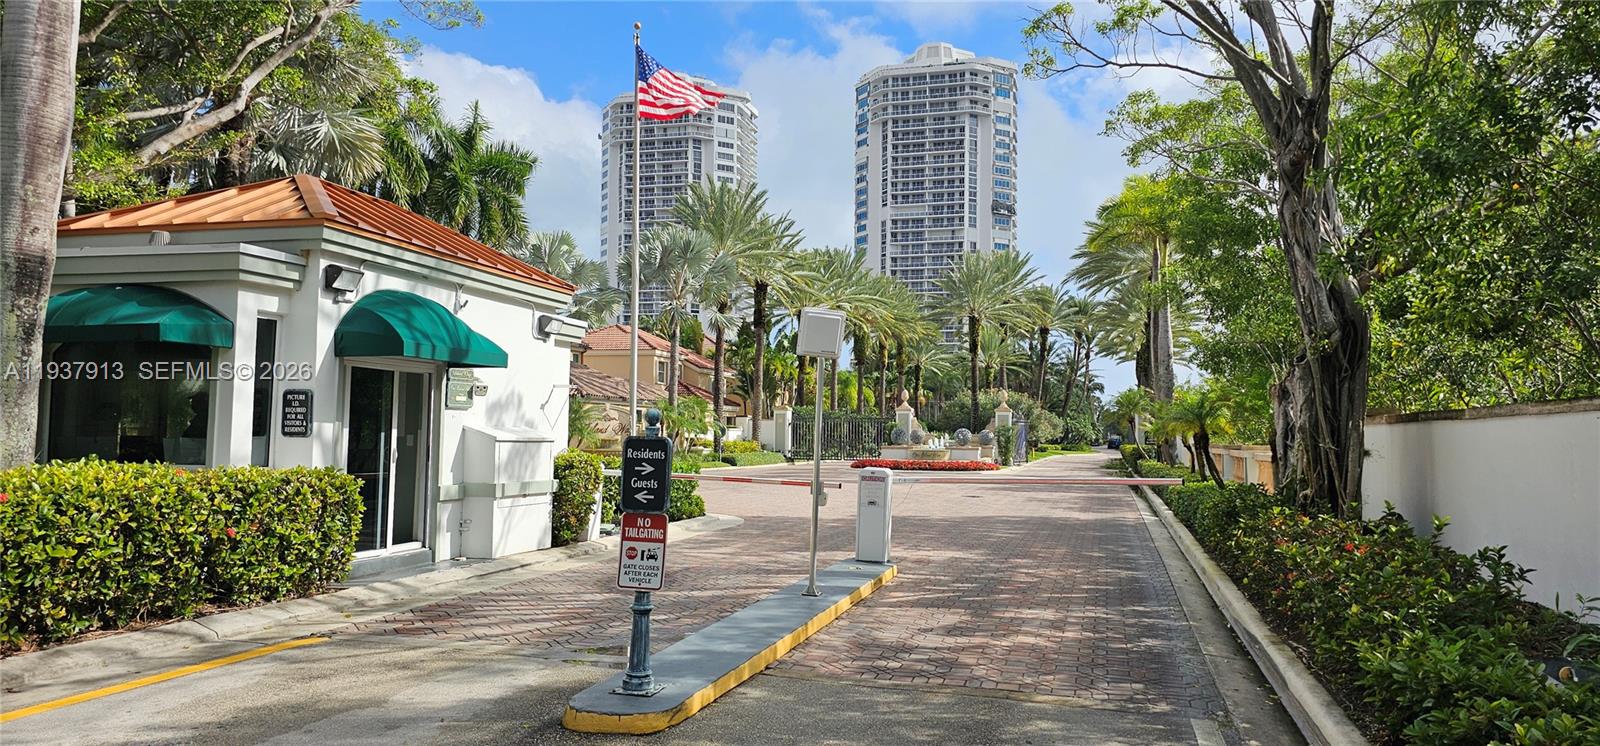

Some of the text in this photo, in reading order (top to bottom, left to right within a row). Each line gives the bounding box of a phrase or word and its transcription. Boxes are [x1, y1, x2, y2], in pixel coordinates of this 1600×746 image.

[627, 448, 665, 460] Residents
[631, 477, 658, 488] Guests
[637, 517, 651, 528] NO
[625, 527, 664, 539] TAILGATING
